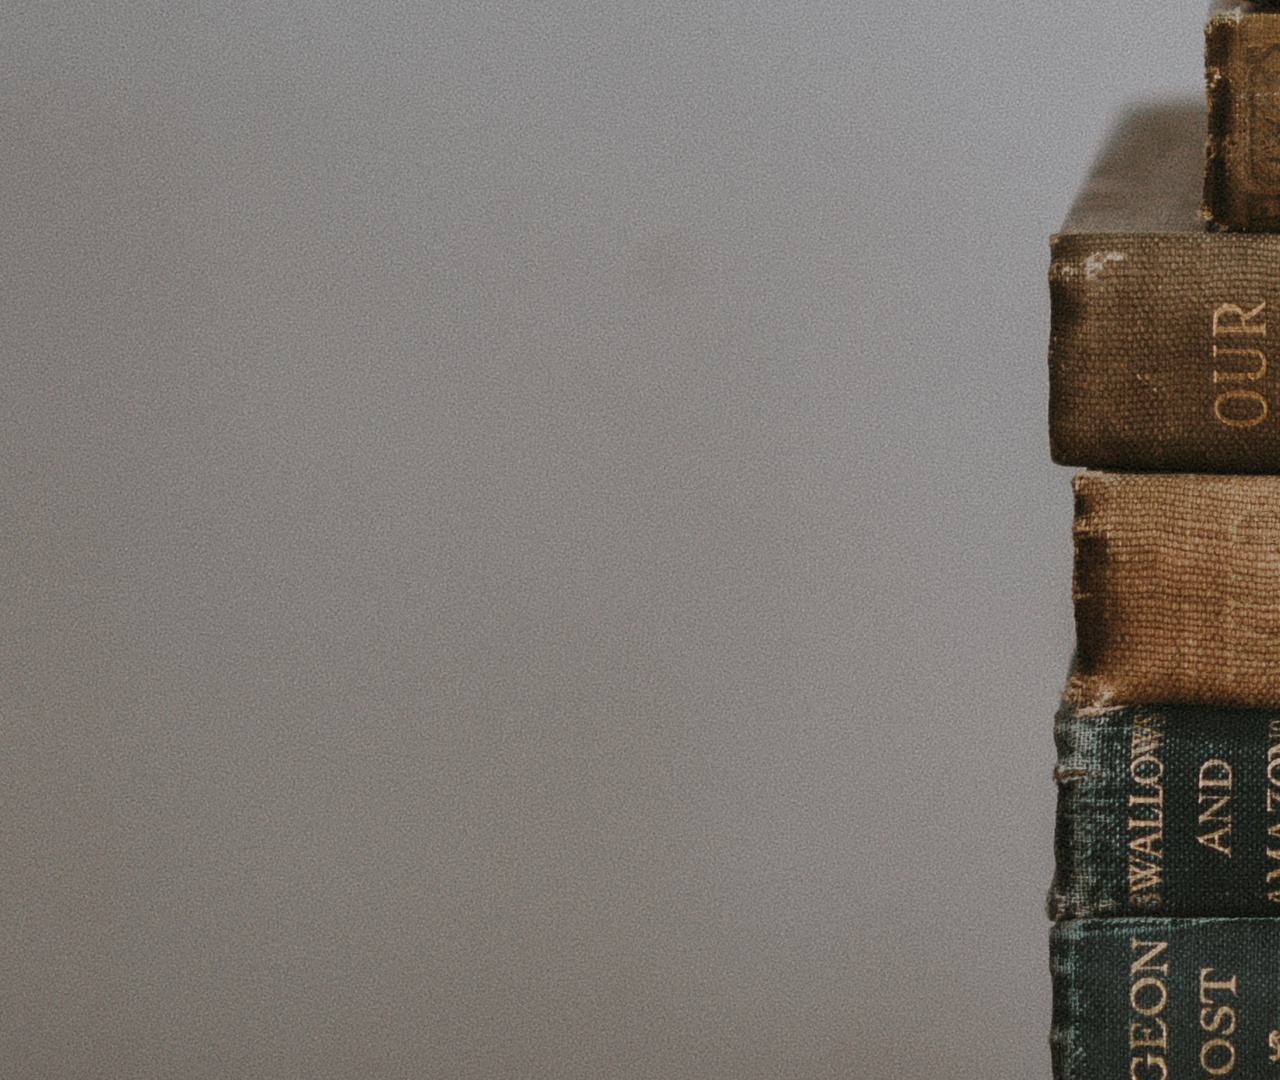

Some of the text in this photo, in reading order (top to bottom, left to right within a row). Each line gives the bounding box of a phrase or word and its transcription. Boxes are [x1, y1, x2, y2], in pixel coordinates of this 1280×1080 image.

[1211, 300, 1269, 428] OUR
[1129, 712, 1165, 906] SWALLOWS
[1197, 758, 1233, 858] AND
